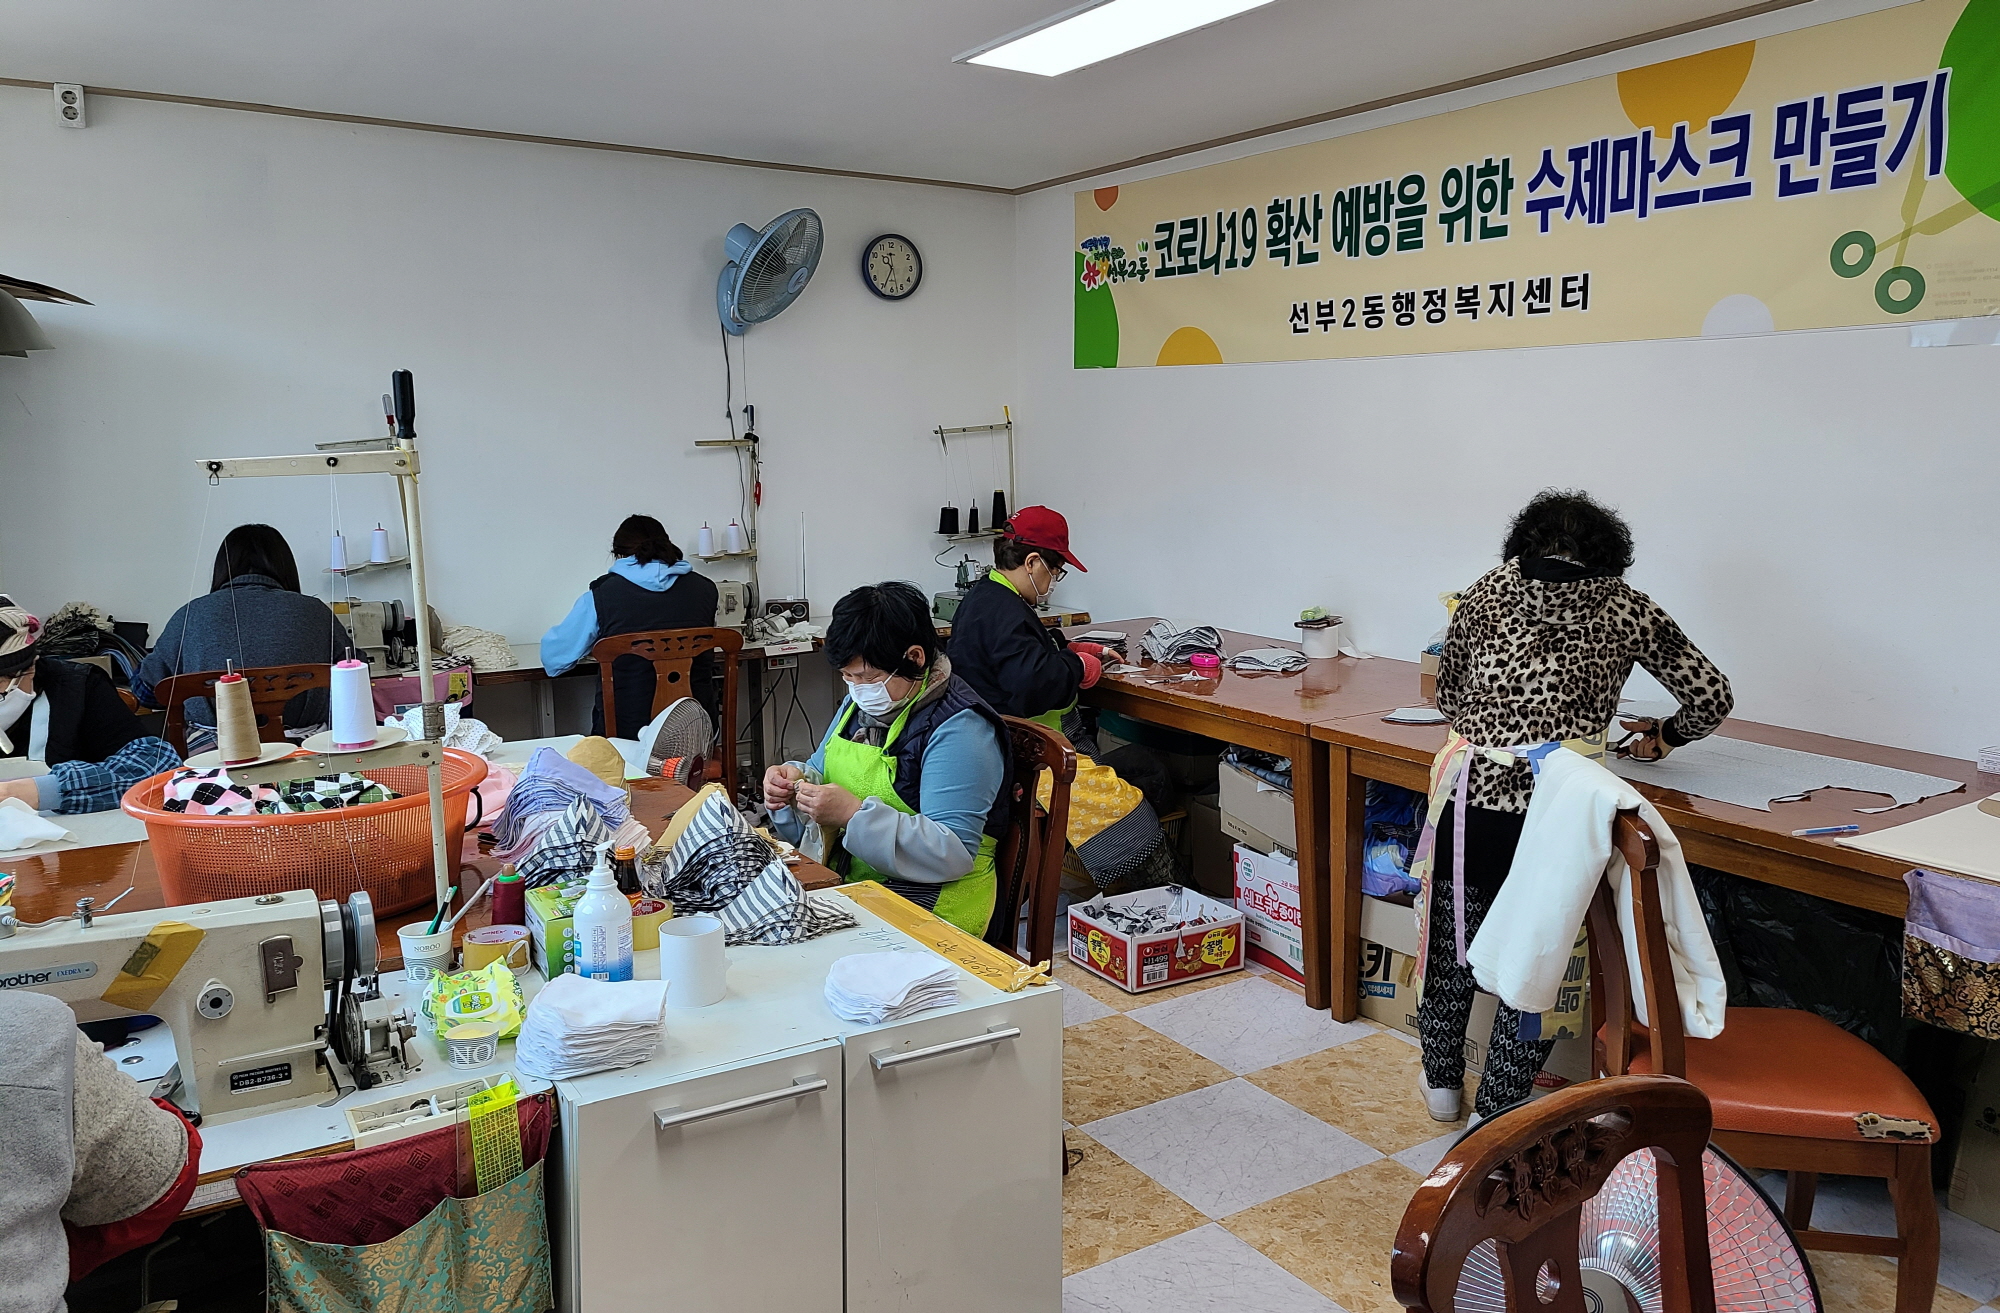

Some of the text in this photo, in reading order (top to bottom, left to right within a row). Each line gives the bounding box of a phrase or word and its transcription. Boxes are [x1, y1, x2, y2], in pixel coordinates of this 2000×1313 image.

[1154, 71, 1949, 279] 코로나19 확산 예방을 위한 수제마스크 만들기
[1289, 273, 1590, 334] 선부2동행정복지센터
[414, 943, 441, 952] NOROO
[1205, 939, 1223, 956] 쫄병
[57, 968, 81, 977] EXEDRA
[453, 1044, 492, 1065] NO
